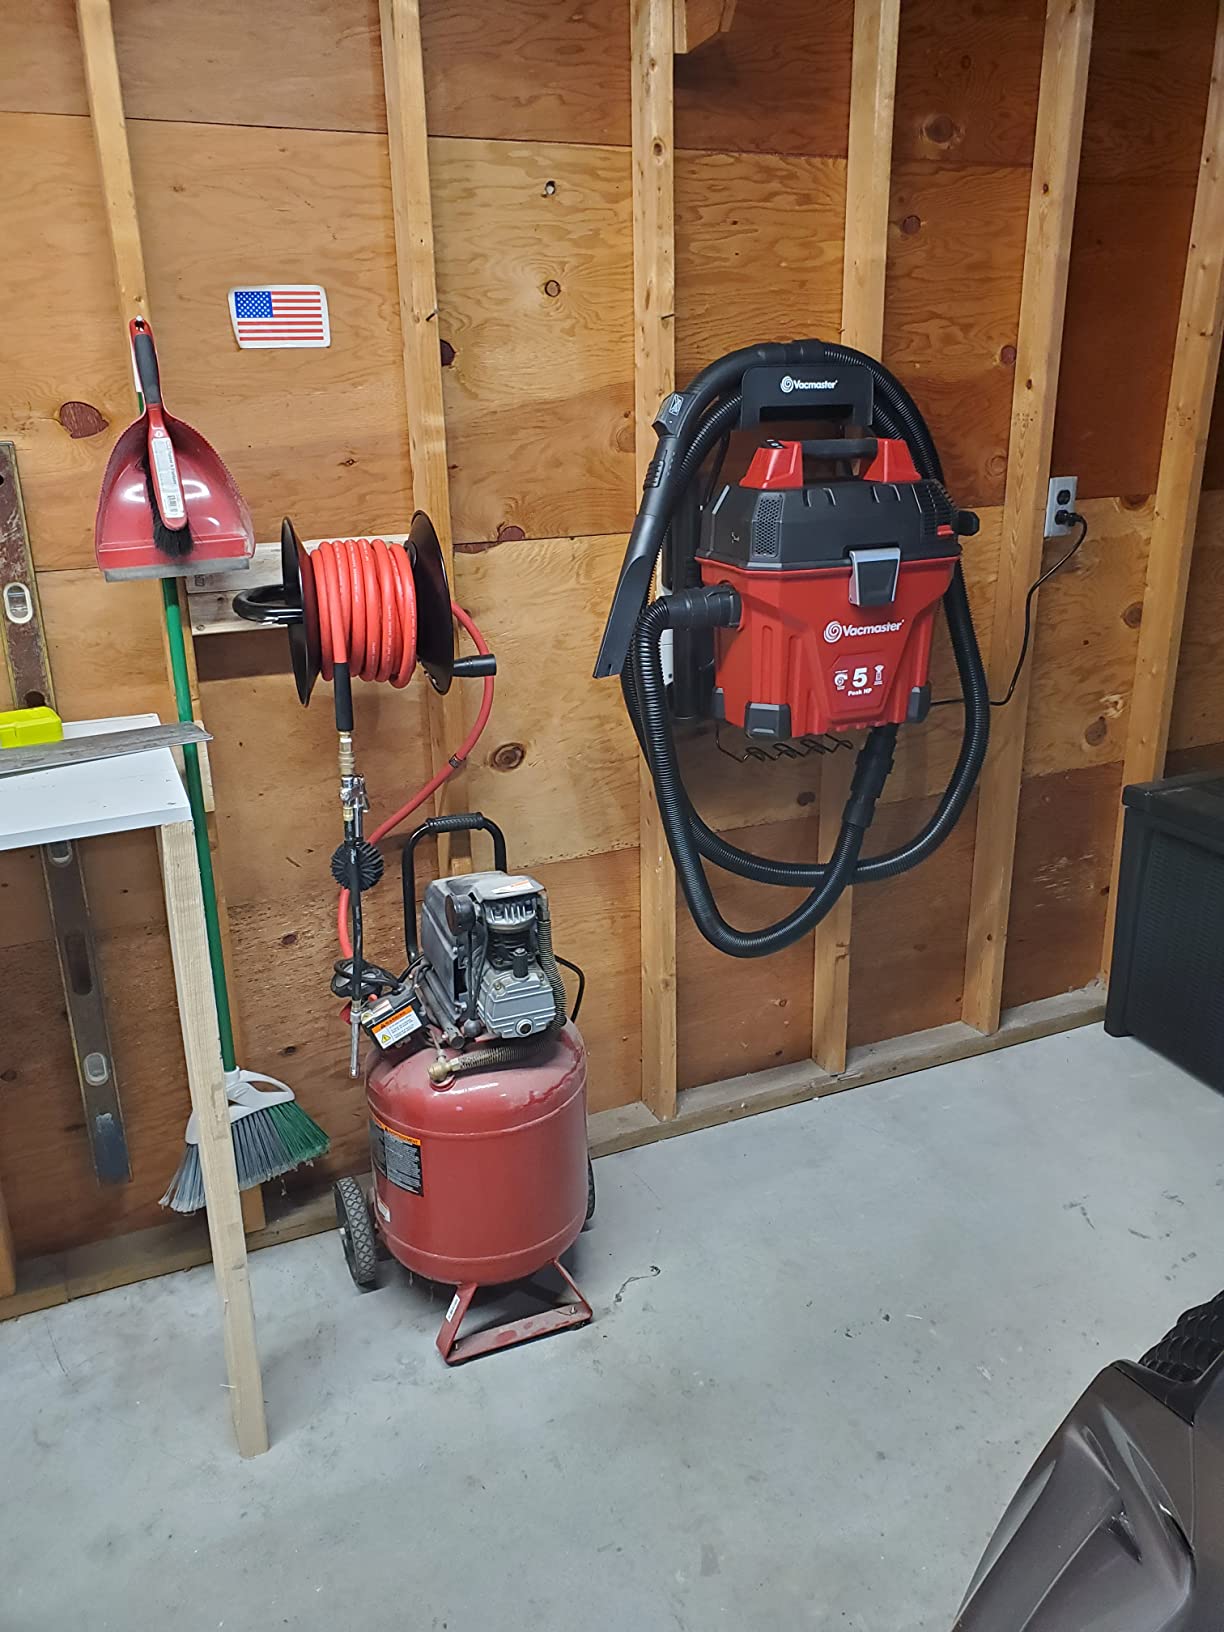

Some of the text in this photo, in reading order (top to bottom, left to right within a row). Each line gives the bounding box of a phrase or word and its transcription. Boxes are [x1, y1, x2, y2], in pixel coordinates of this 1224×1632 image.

[793, 379, 836, 389] Vacmaster
[842, 621, 903, 637] Vacmaster
[852, 667, 868, 688] 5
